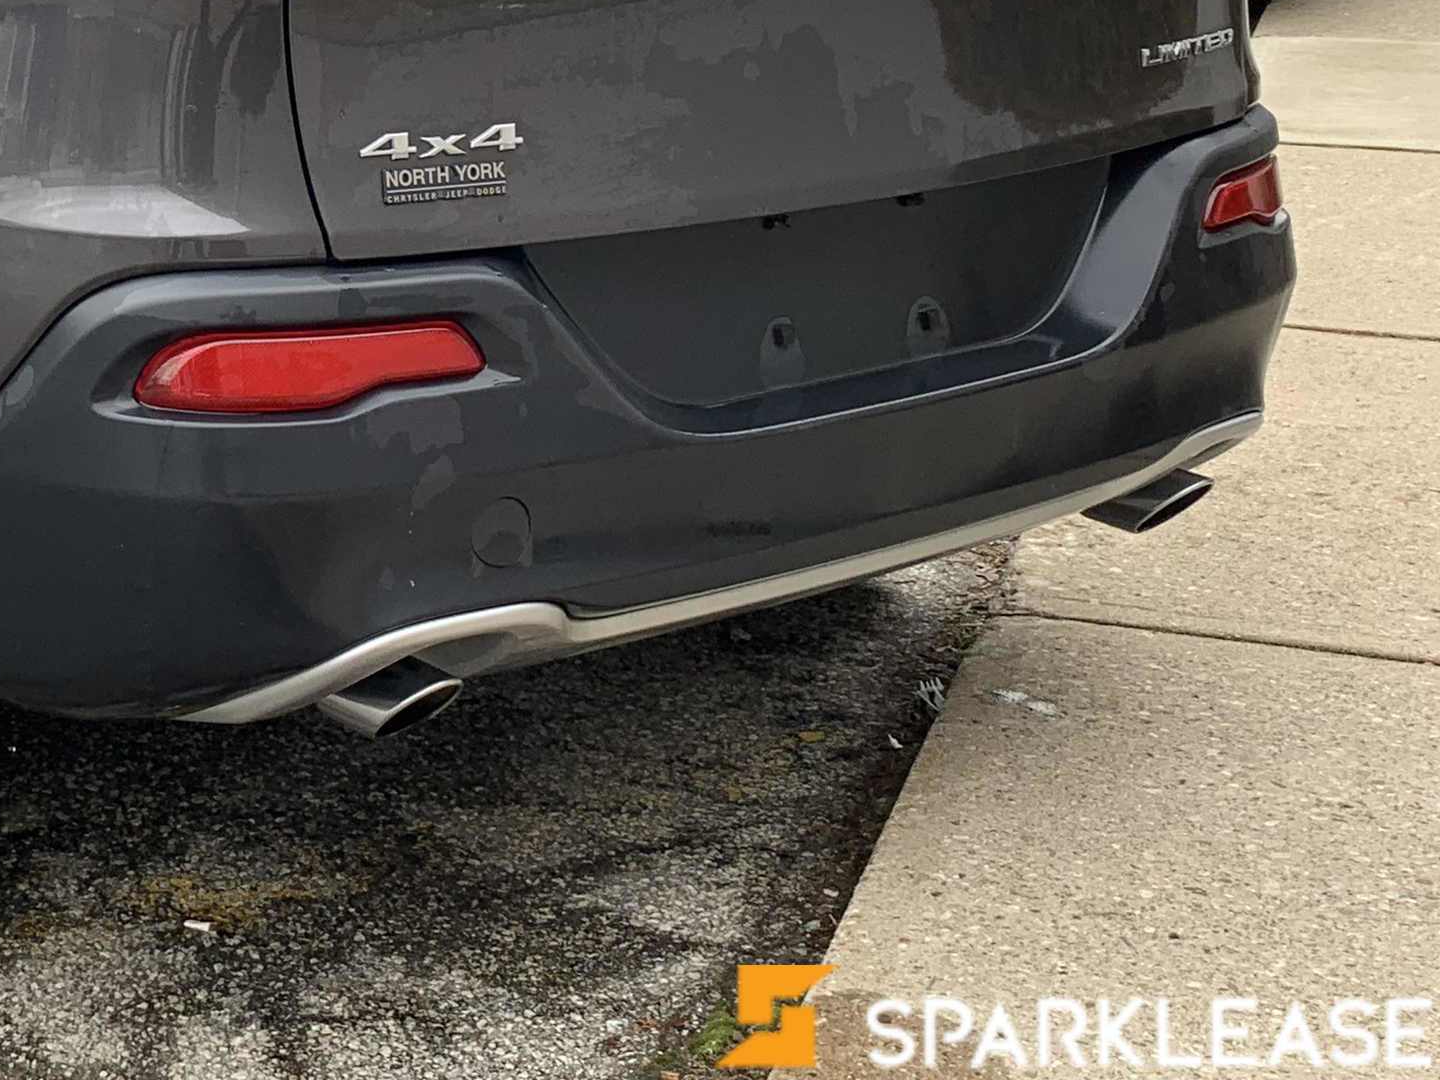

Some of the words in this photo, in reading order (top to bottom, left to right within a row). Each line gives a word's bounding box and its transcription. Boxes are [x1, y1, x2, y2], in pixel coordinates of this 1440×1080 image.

[1141, 28, 1234, 68] LIMITED
[360, 123, 524, 161] 4x4
[385, 166, 450, 188] NORTH
[456, 161, 506, 181] YORK
[386, 191, 438, 204] CHRYSLER
